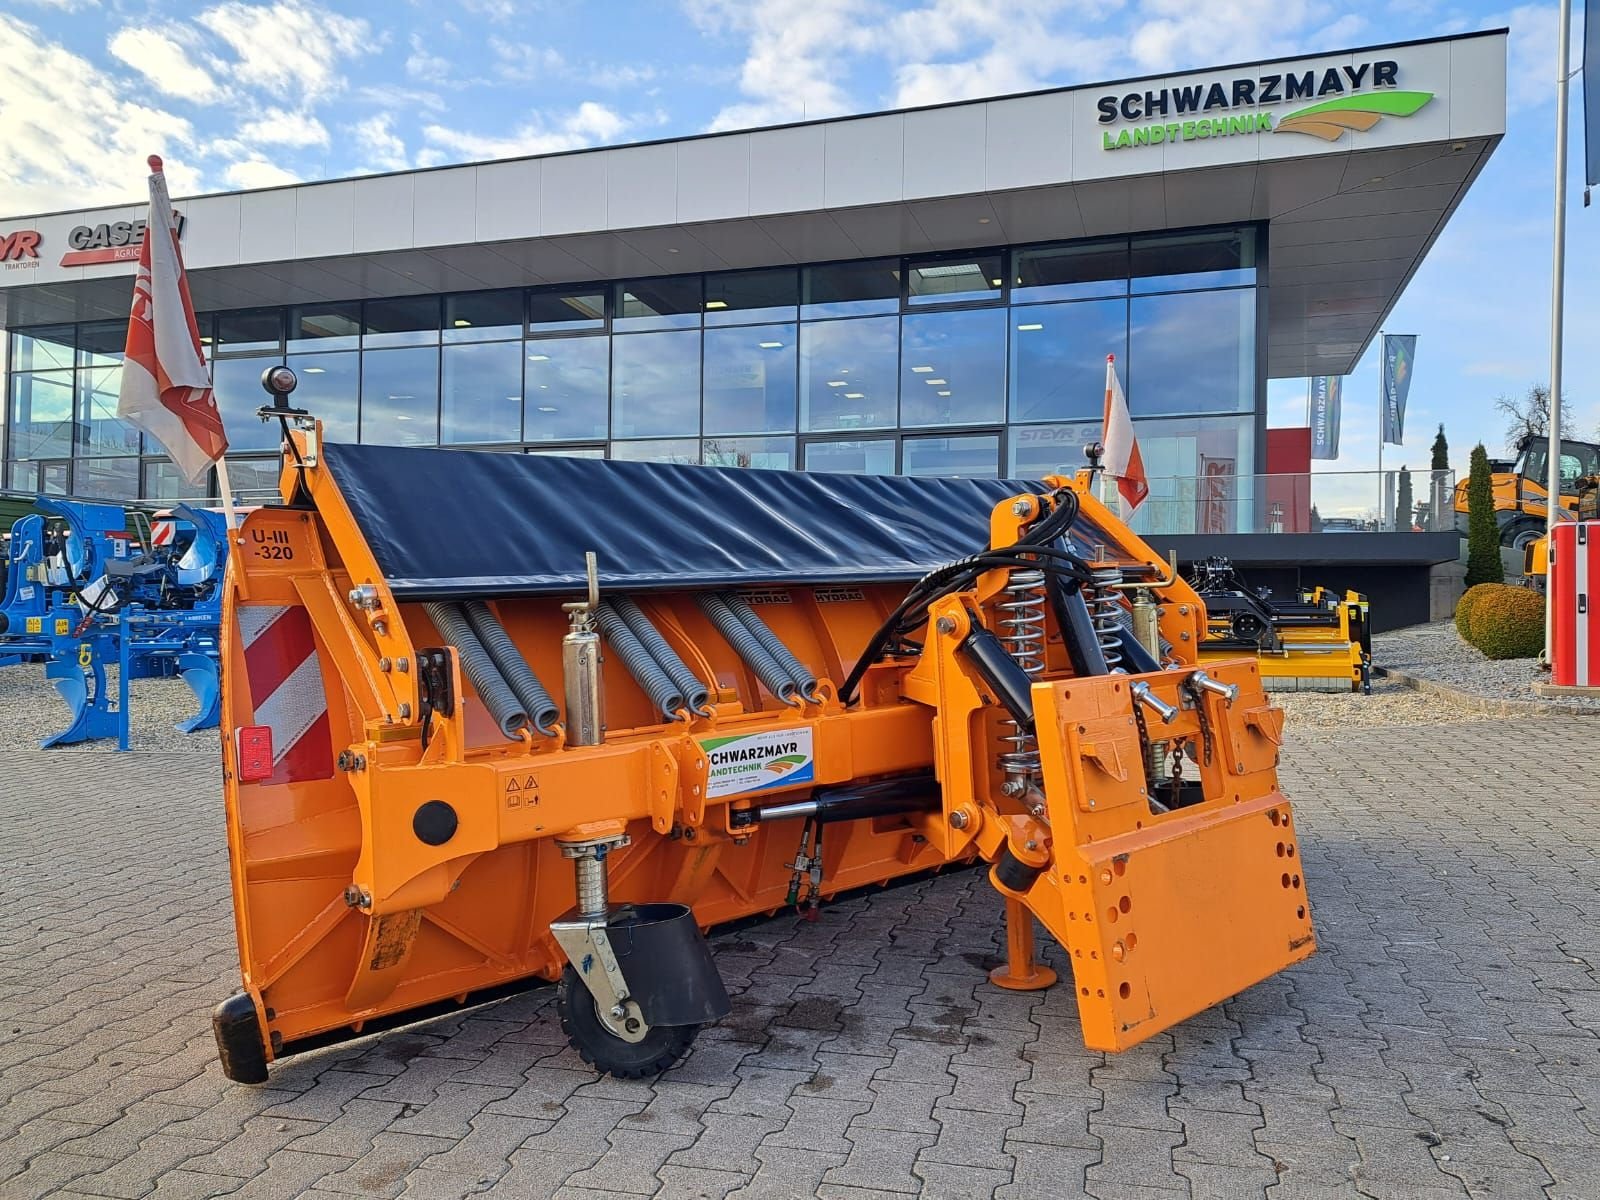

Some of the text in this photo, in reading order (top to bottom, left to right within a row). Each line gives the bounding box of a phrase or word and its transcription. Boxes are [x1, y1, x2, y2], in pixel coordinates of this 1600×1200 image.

[1097, 60, 1399, 125] SCHWARZMAYR
[1103, 112, 1274, 151] LANDTECHNIK
[114, 247, 141, 259] AGRIC
[5, 261, 40, 270] TRAKTOREN
[252, 529, 289, 544] U-III
[254, 545, 293, 560] -320
[816, 592, 863, 602] HYDRAC
